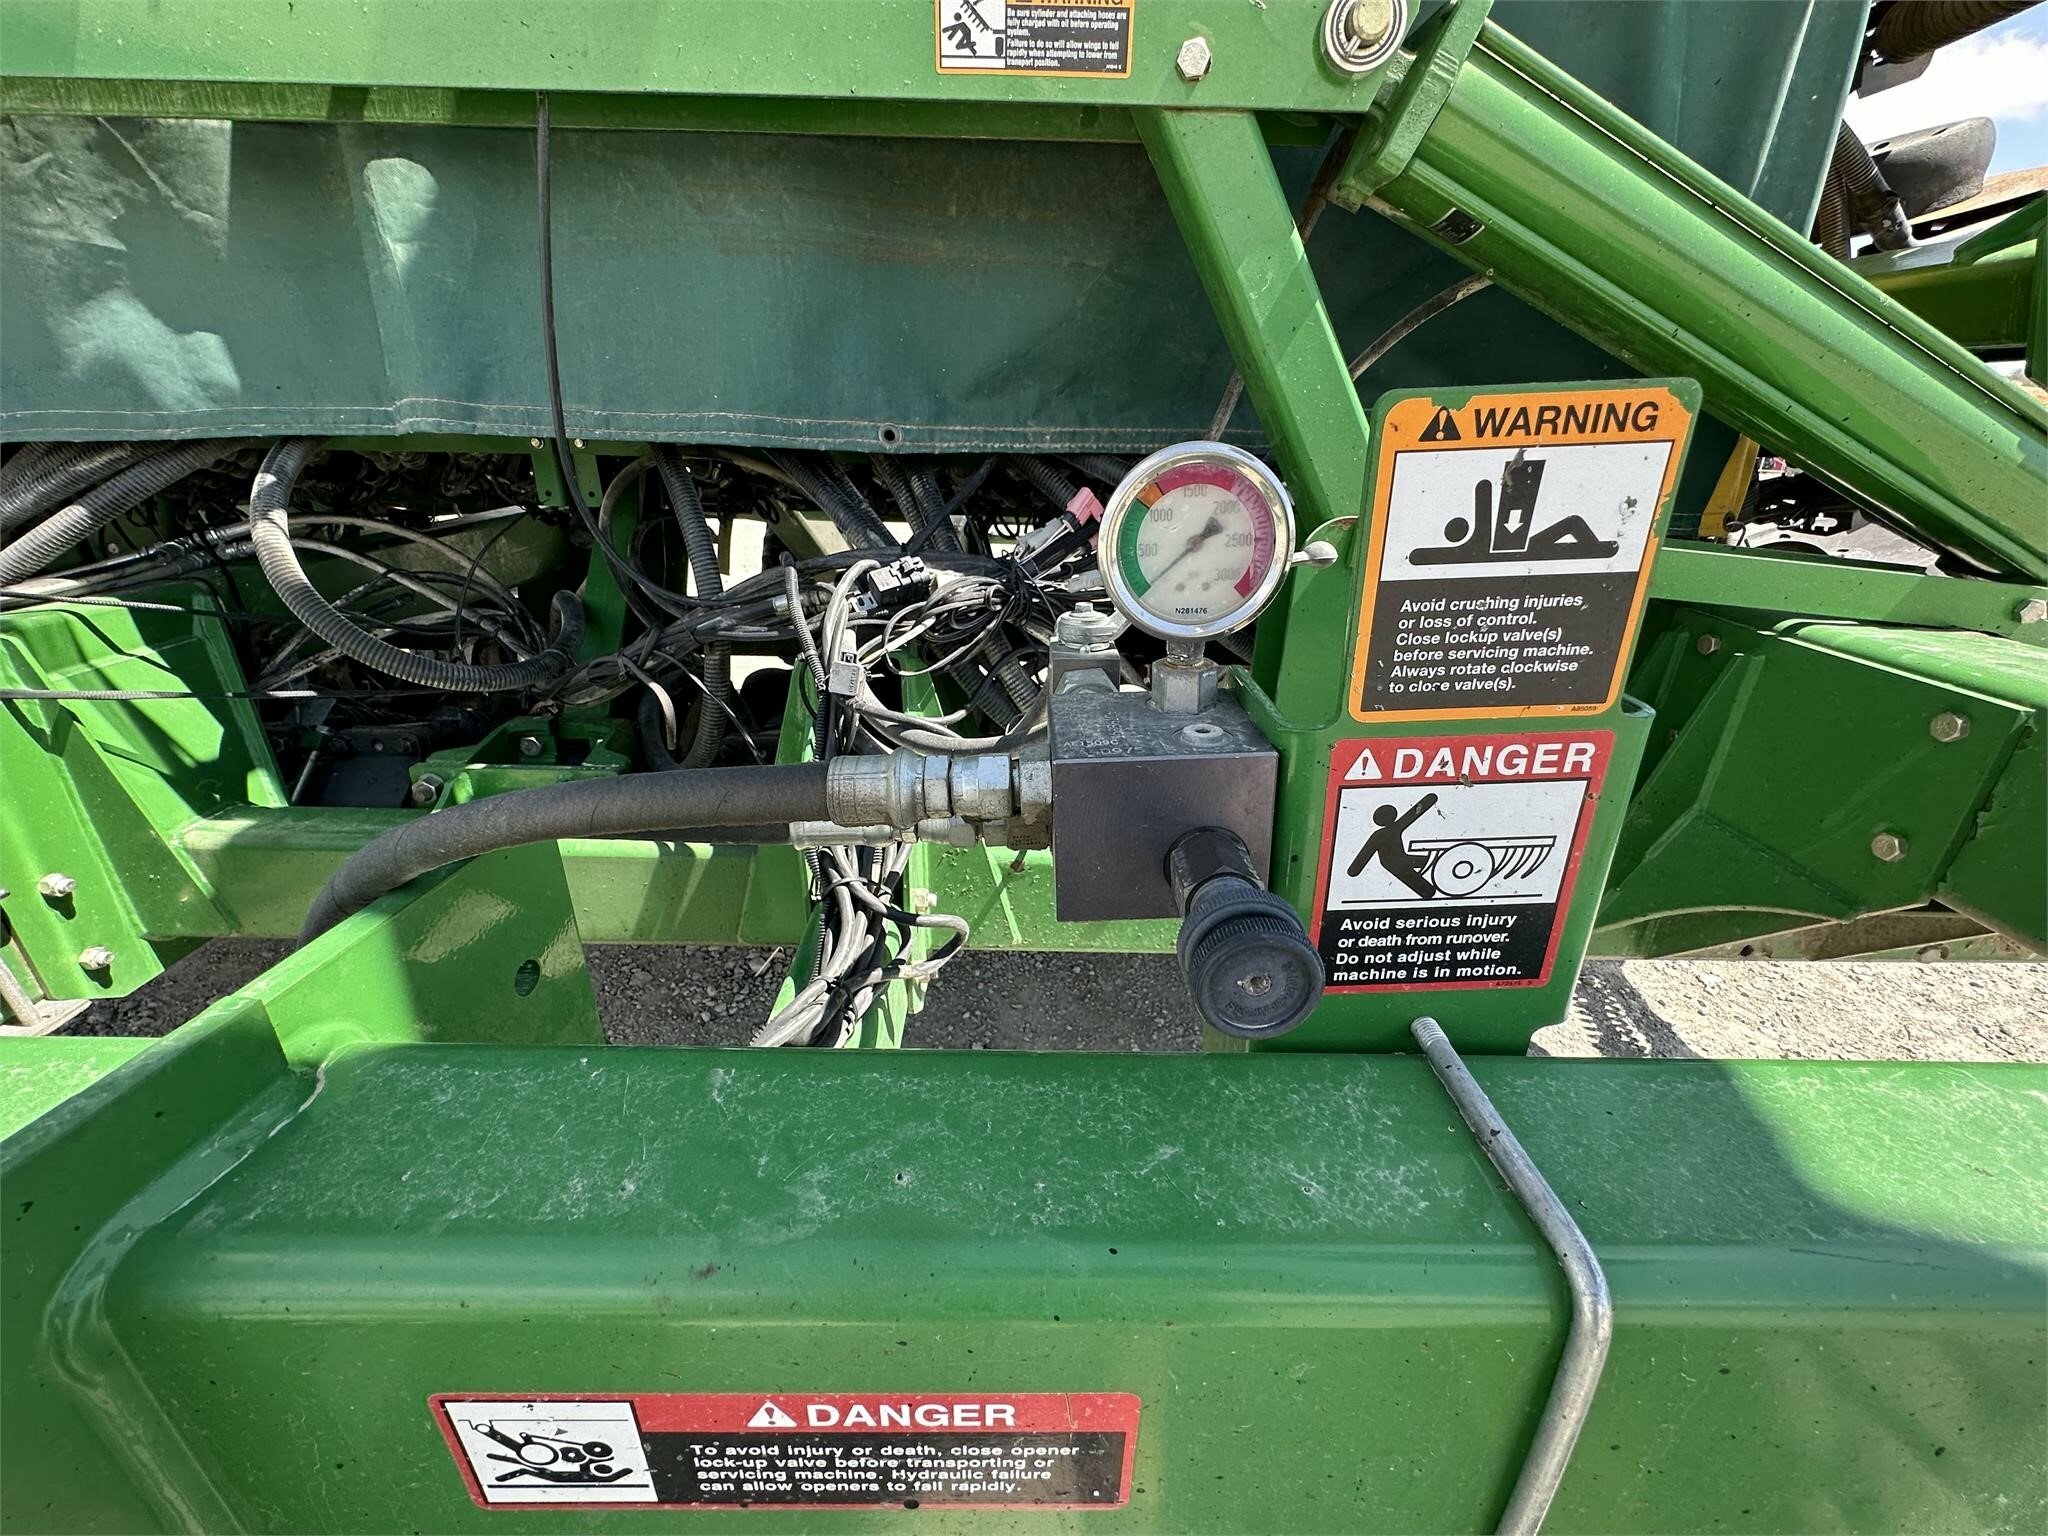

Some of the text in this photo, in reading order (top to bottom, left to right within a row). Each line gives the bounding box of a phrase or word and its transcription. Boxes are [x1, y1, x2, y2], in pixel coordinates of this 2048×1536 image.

[1007, 8, 1015, 16] Be
[1017, 9, 1030, 17] sure
[1031, 9, 1055, 19] cylinder
[1057, 10, 1067, 18] and
[1069, 9, 1096, 20] attaching
[1098, 10, 1115, 19] hoses
[1007, 18, 1020, 29] fully
[1022, 19, 1045, 28] charged
[1047, 19, 1059, 27] with
[1070, 19, 1089, 28] before
[1091, 20, 1118, 30] operating
[1007, 29, 1030, 37] system.
[1007, 39, 1027, 47] Failure
[1054, 40, 1065, 48] will
[1066, 40, 1082, 49] allow
[1084, 41, 1101, 51] wings
[1110, 42, 1119, 50] fall
[1007, 49, 1027, 58] rapidly
[1029, 49, 1044, 57] when
[1046, 50, 1077, 59] attempting
[1086, 51, 1102, 59] lower
[1104, 51, 1117, 59] from
[1007, 58, 1060, 67] transport position.
[1474, 400, 1658, 439] WARNING
[1149, 508, 1173, 522] 1000
[1225, 533, 1252, 547] 2500
[1139, 544, 1157, 556] 500
[1401, 595, 1582, 613] Avoid crushing injuries
[1399, 613, 1537, 630] or loss of control.
[1396, 627, 1562, 647] Close lockup valve(s)
[1394, 643, 1593, 662] before servicing machine.
[1391, 660, 1577, 679] Always rotate clockwise
[1389, 681, 1405, 693] to
[1455, 677, 1515, 691] valve(s).
[1393, 743, 1595, 778] DANGER
[1340, 915, 1517, 931] Avoid serious injury
[1338, 932, 1510, 947] or death from runover.
[1336, 949, 1501, 965] Do not adjust while
[1333, 965, 1521, 981] machine is in motion.
[806, 1404, 1015, 1426] DANGER
[690, 1444, 1079, 1458] To avoid injury or death, close opener
[694, 1457, 1054, 1470] lock-up valve before transporting or
[697, 1470, 1051, 1482] servicing machine. Hydraulic failure
[700, 1481, 1021, 1493] can allow openers to fall rapidly.
